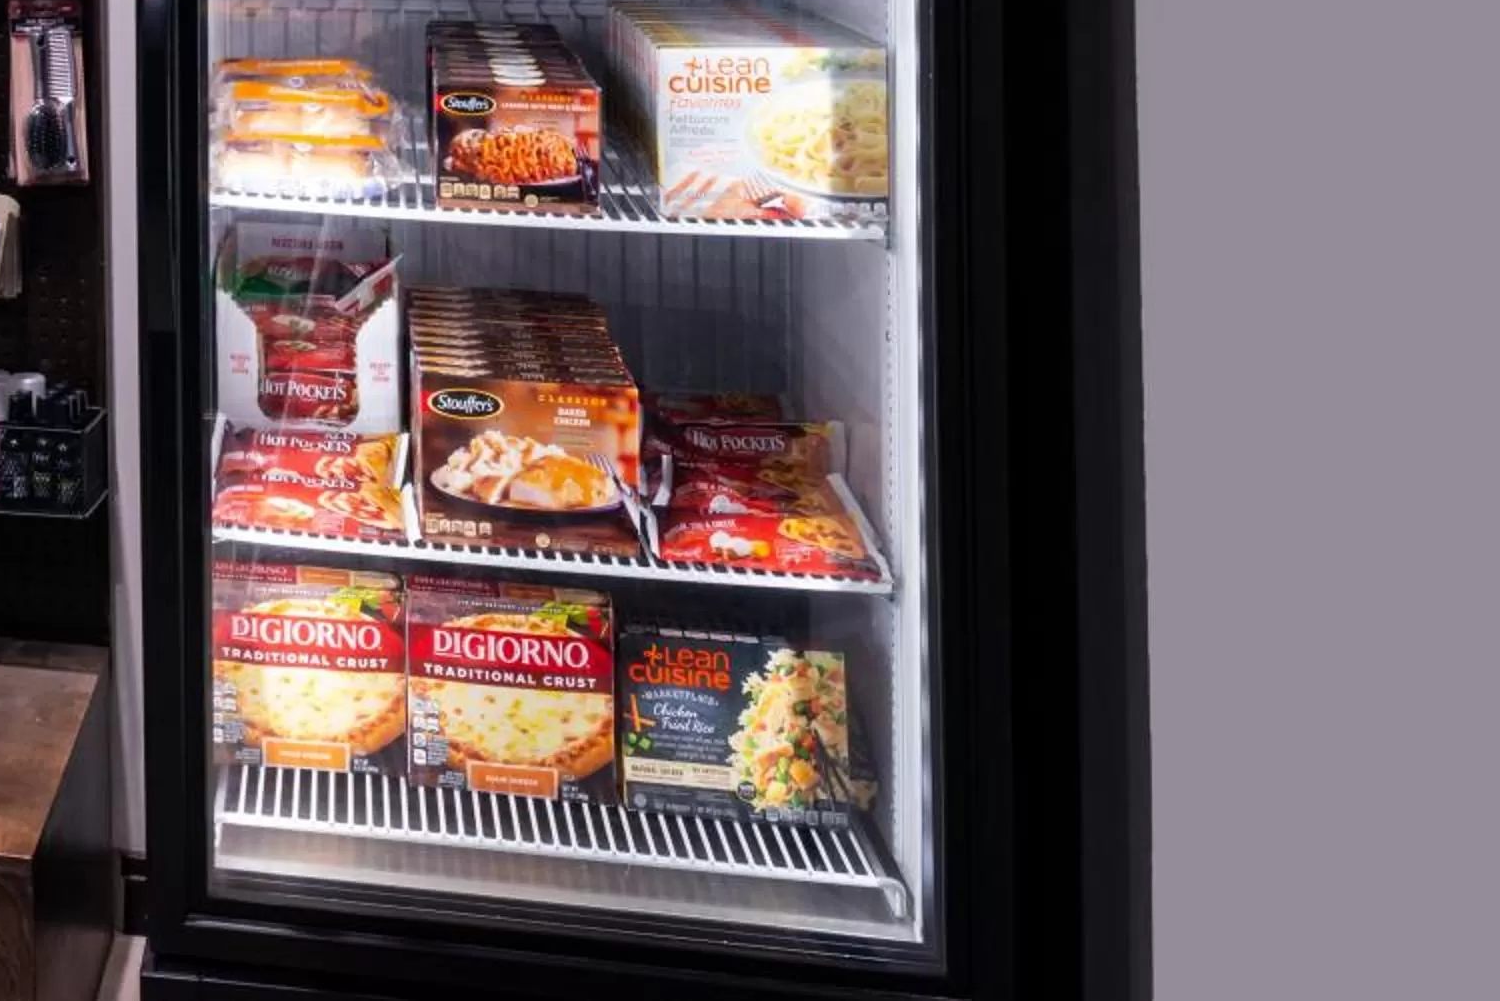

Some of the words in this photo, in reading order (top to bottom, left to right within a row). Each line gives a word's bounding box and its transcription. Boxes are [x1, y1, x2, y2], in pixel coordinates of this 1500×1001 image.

[287, 380, 347, 400] POCKETS
[437, 390, 495, 414] Stouffer's
[221, 646, 330, 667] TRADITIONAL
[336, 656, 389, 670] CRUST
[424, 661, 537, 686] TRADITIONAL
[543, 674, 597, 690] CRUST
[653, 702, 698, 718] Chicken
